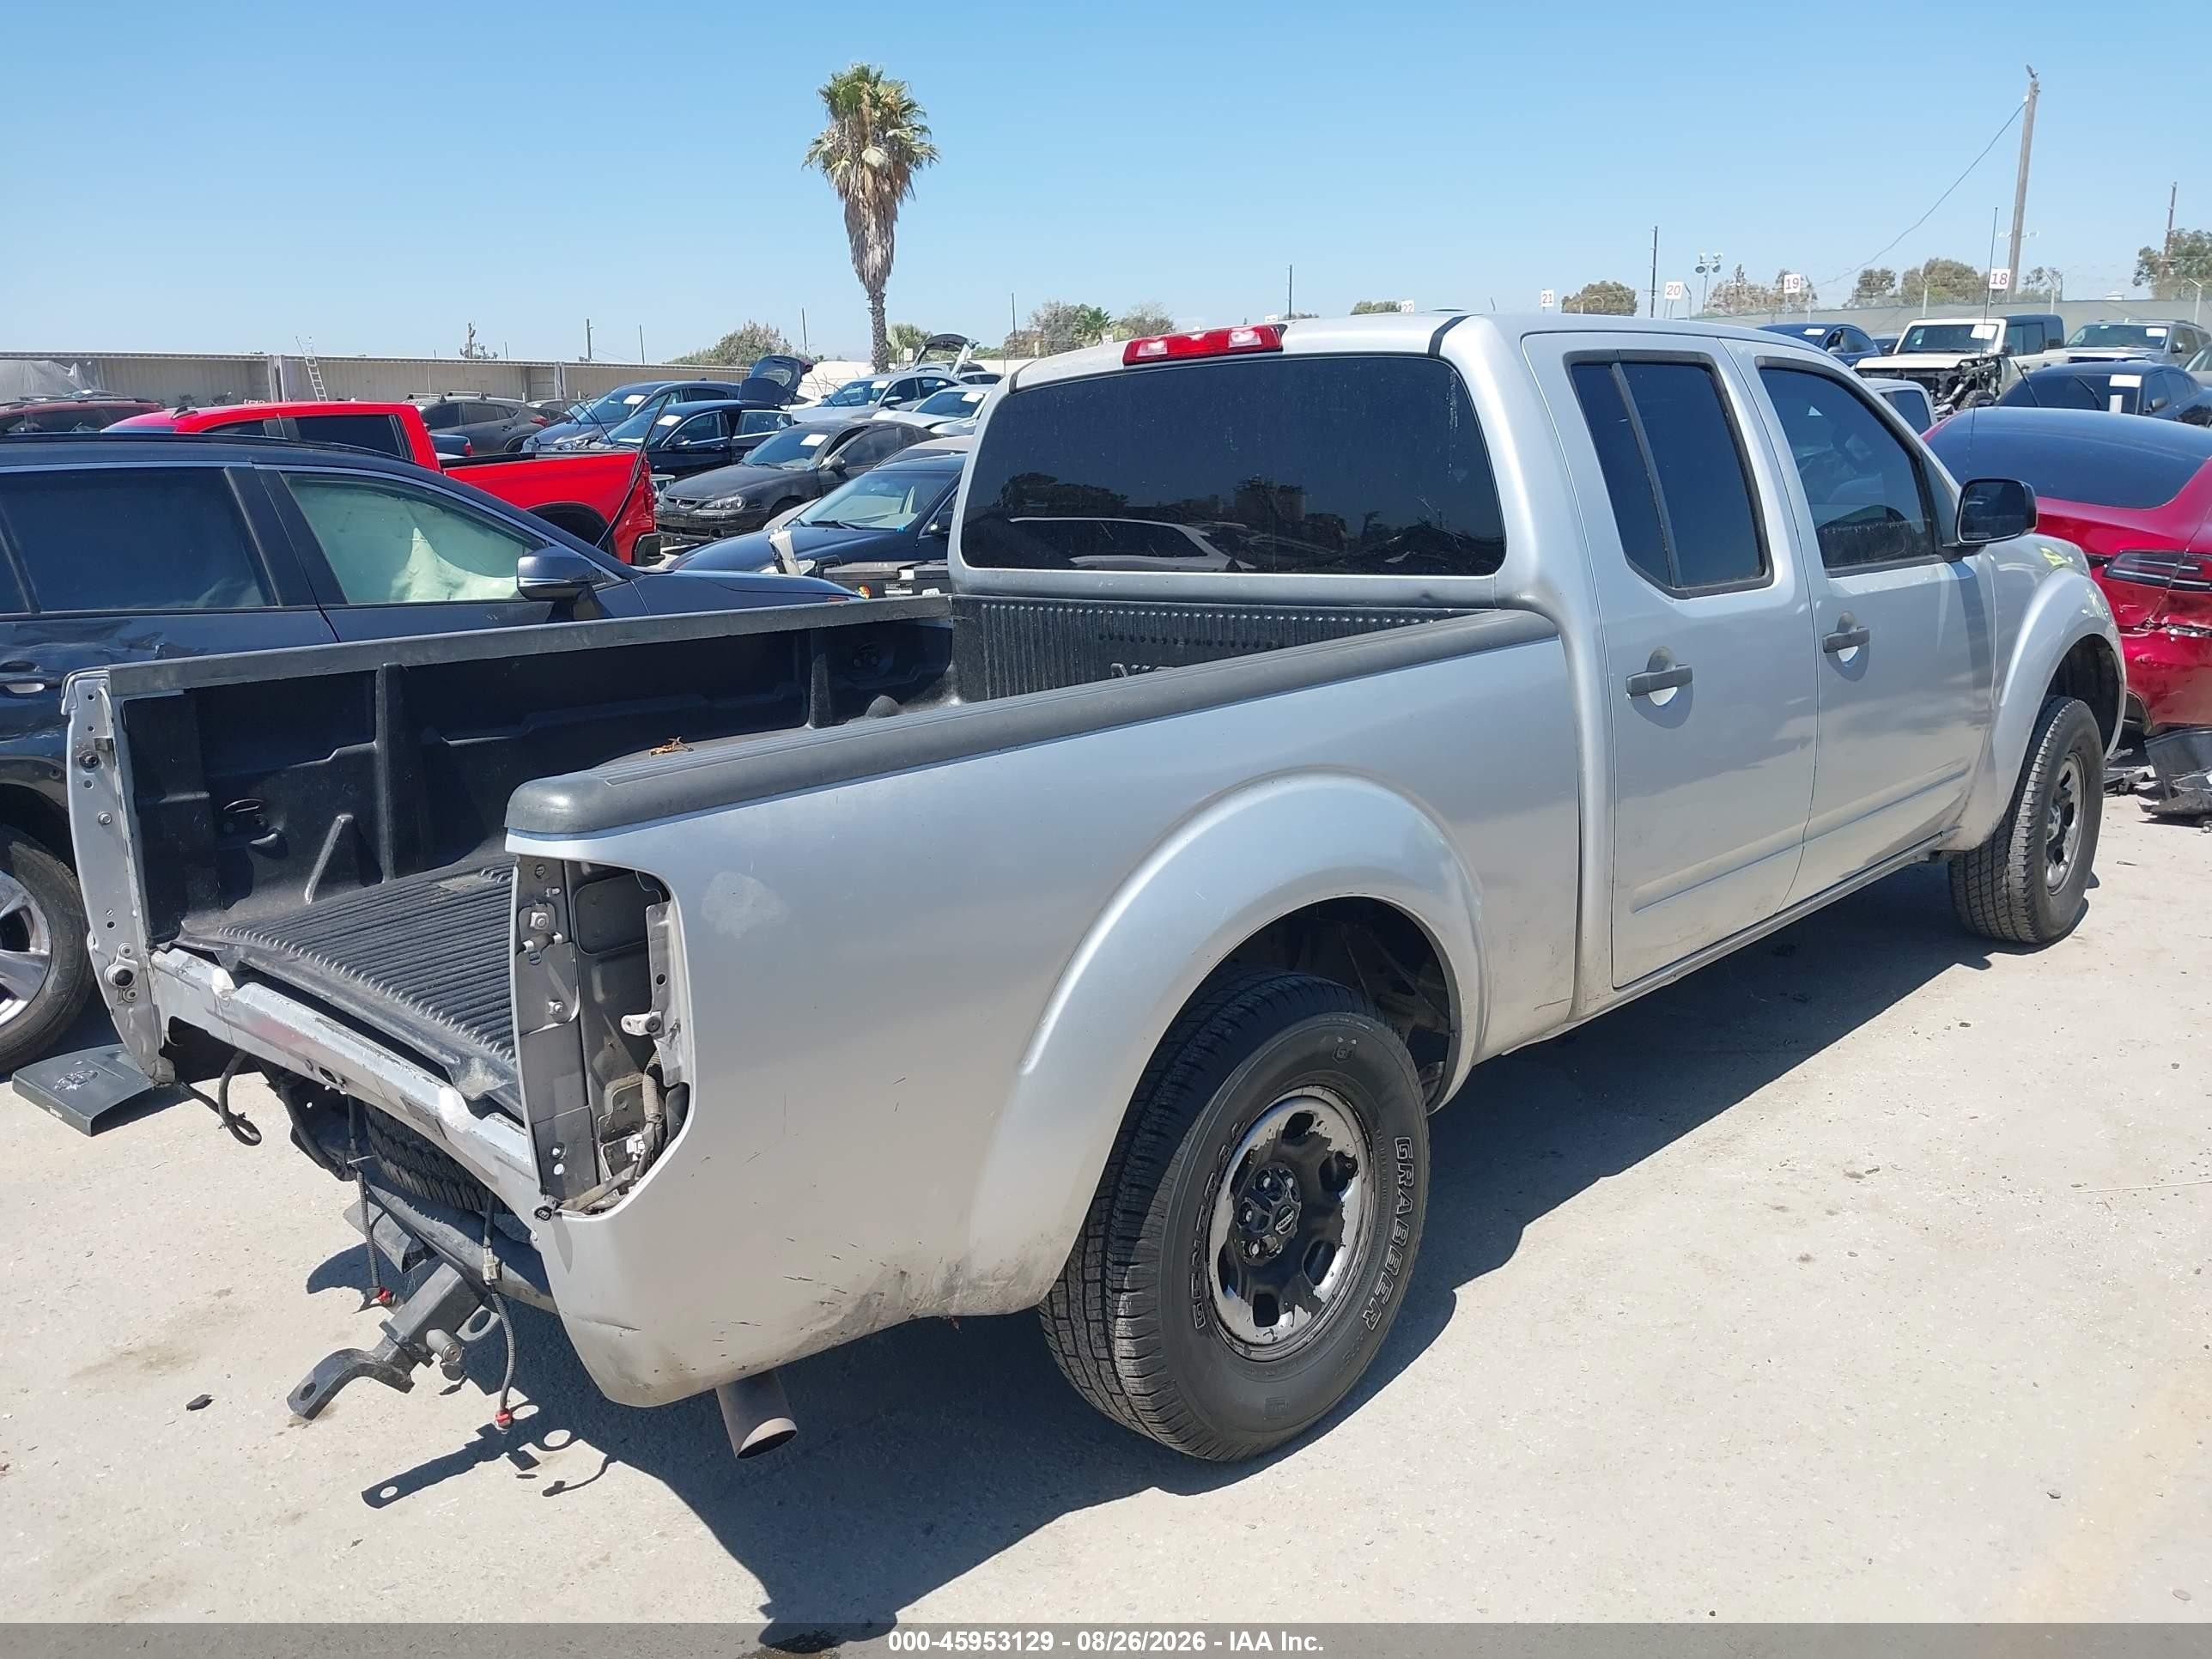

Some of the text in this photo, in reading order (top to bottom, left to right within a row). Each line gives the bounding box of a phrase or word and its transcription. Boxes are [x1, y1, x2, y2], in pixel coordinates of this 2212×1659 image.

[1785, 276, 1800, 290] 19
[1990, 272, 2008, 285] 18
[1666, 284, 1681, 296] 20
[1541, 293, 1553, 304] 21
[1362, 1136, 1415, 1331] GRABBER
